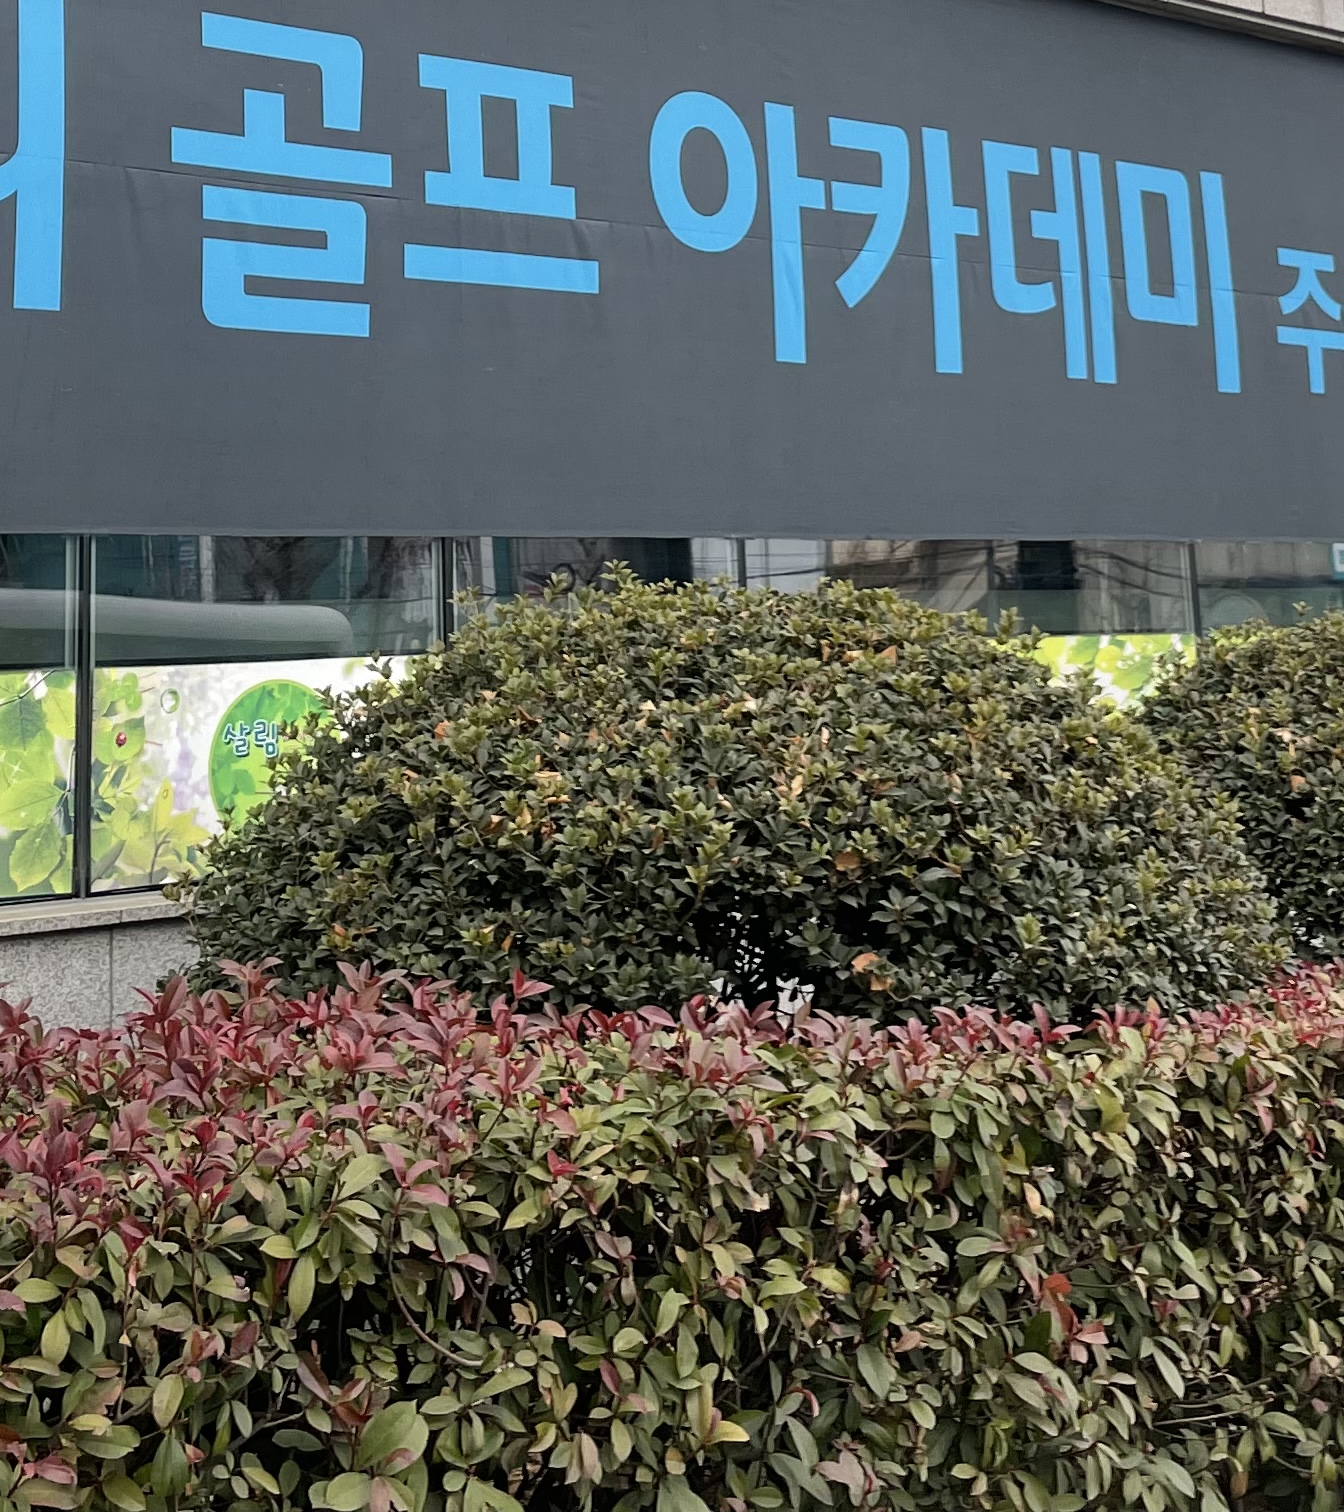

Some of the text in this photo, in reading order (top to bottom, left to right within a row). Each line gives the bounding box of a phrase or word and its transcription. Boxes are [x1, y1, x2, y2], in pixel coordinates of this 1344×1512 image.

[171, 12, 600, 338] 골프
[649, 90, 1242, 394] 아카데미
[223, 719, 280, 759] 살림
